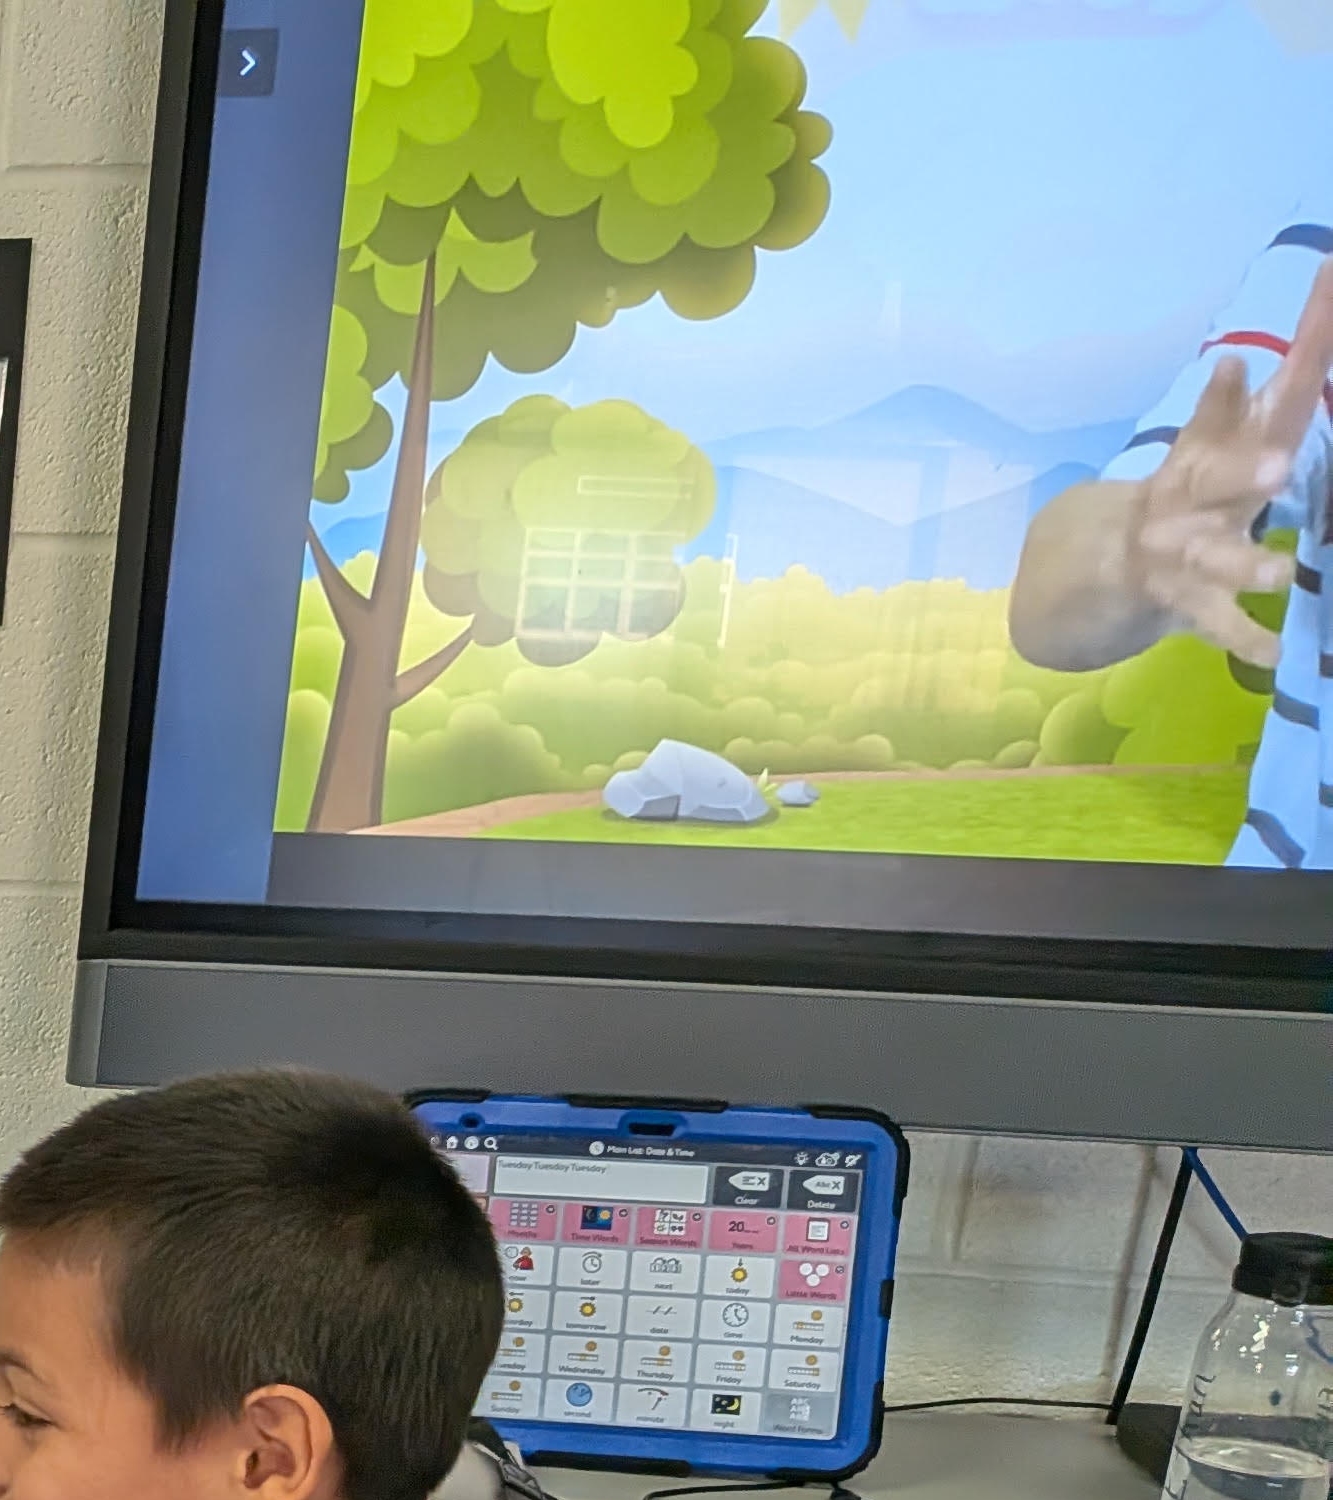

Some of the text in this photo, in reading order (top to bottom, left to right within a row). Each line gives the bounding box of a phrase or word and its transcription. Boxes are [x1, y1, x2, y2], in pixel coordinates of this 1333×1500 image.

[497, 1160, 607, 1174] Tuesday Tuesday Tuesday
[734, 1194, 760, 1206] Clear
[807, 1200, 837, 1210] Delete
[592, 1233, 620, 1244] Words
[565, 1322, 607, 1331] tomorrow
[789, 1335, 825, 1345] Monday
[558, 1364, 606, 1376] Wednesday
[636, 1369, 675, 1381] Thursday
[715, 1375, 742, 1385] Friday
[783, 1379, 821, 1390] Saturday
[490, 1404, 521, 1415] Sunday
